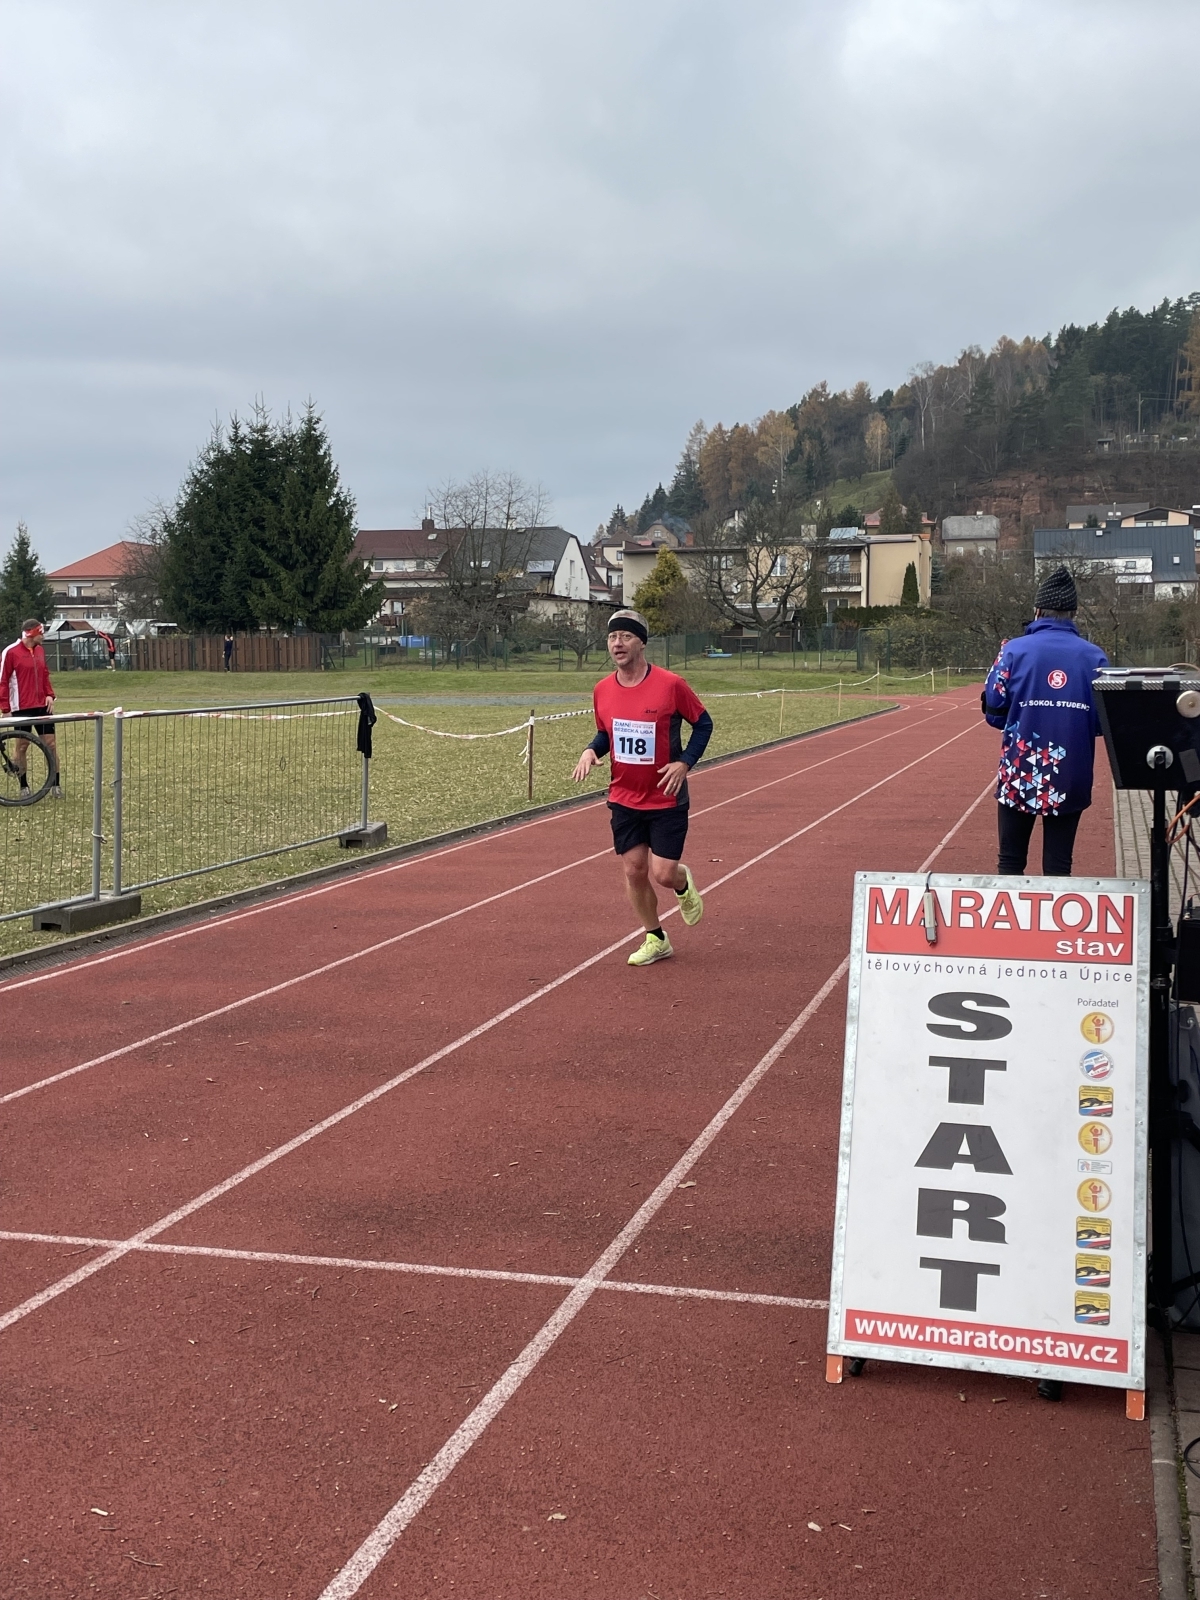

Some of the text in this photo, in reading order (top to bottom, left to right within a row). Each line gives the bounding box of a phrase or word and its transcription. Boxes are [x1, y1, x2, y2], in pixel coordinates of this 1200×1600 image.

[619, 737, 646, 755] 118
[866, 887, 1134, 934] MARATON
[1056, 938, 1124, 957] stav
[867, 958, 1133, 983] tělovýchovná jednota Úpice
[1077, 998, 1119, 1008] Pořadatel
[914, 991, 1014, 1312] START
[854, 1318, 1118, 1365] www.maratonstav.cz
